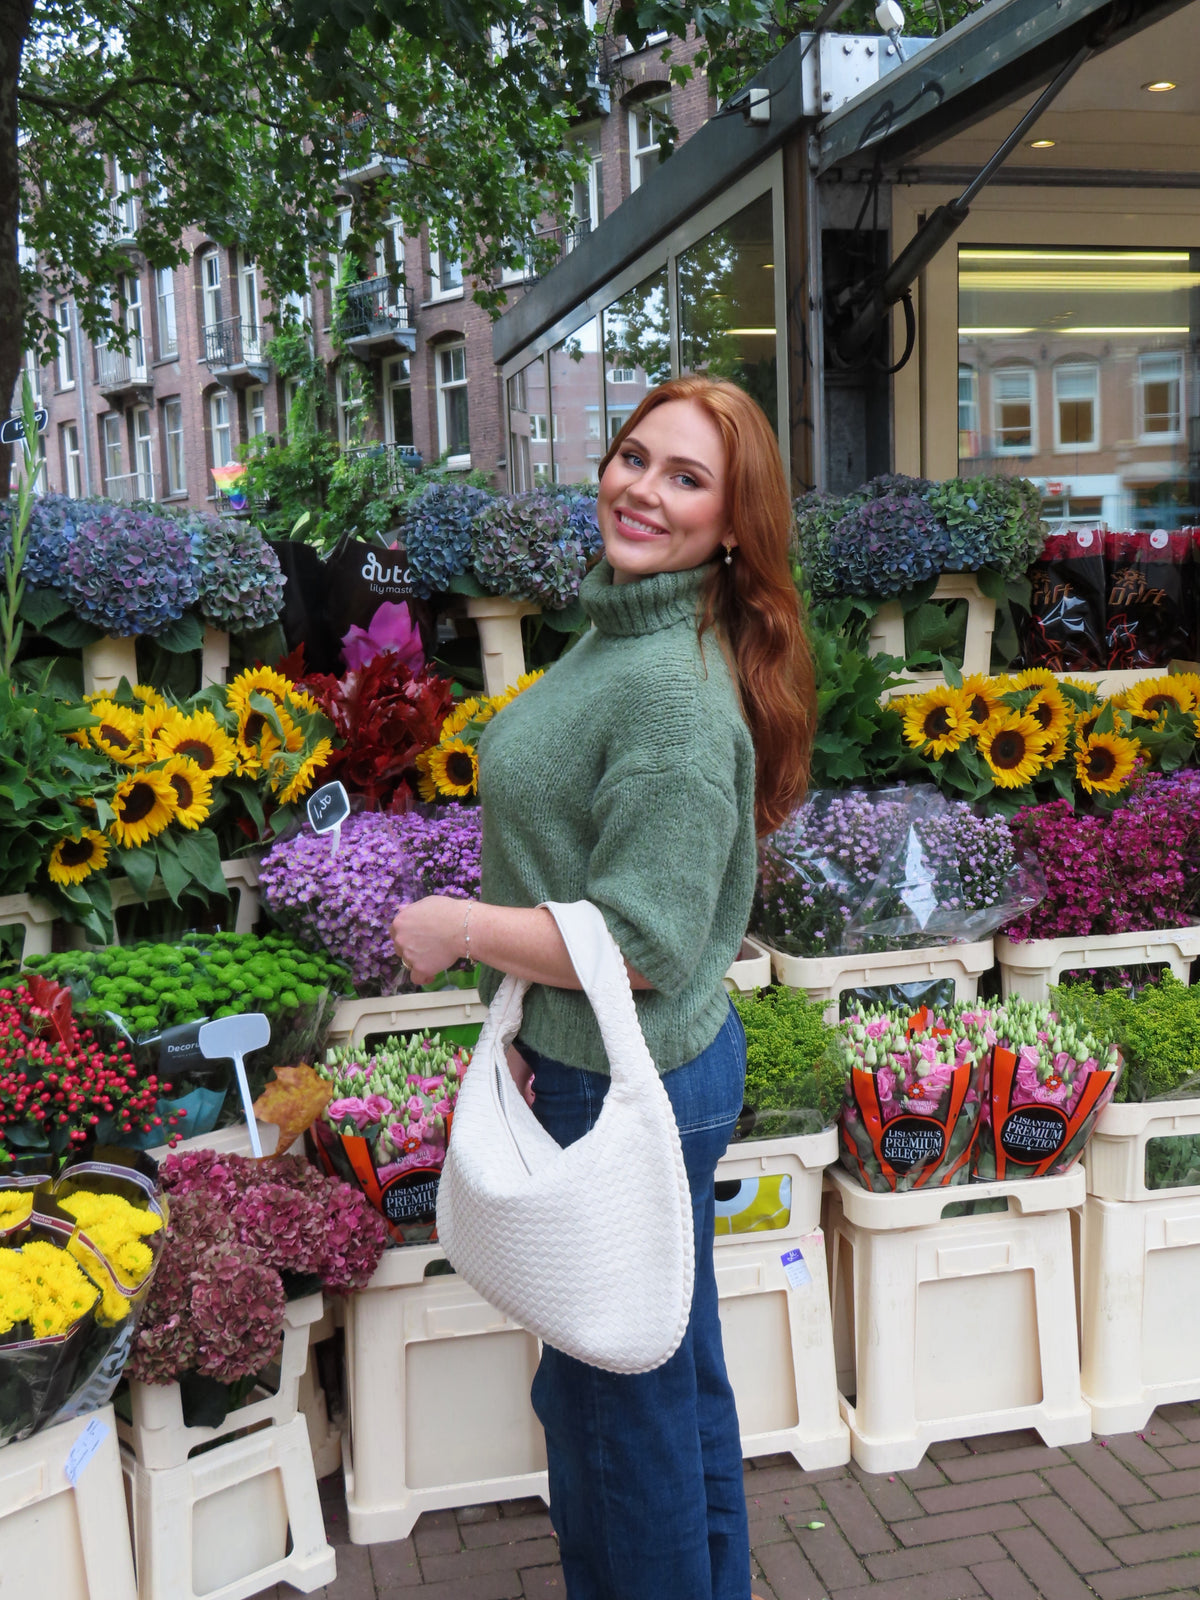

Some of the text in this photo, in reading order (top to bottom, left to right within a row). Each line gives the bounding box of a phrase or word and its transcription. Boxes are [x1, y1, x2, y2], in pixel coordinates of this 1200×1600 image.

[370, 583, 385, 594] lily
[1012, 1114, 1064, 1129] LISIANTHUS
[888, 1129, 942, 1138] LISIANTHUS
[1006, 1121, 1064, 1140] PREMIUM
[885, 1136, 943, 1150] PREMIUM
[1002, 1132, 1060, 1149] SELECTION
[884, 1147, 941, 1160] SELECTION
[386, 1188, 439, 1208] PREMIU
